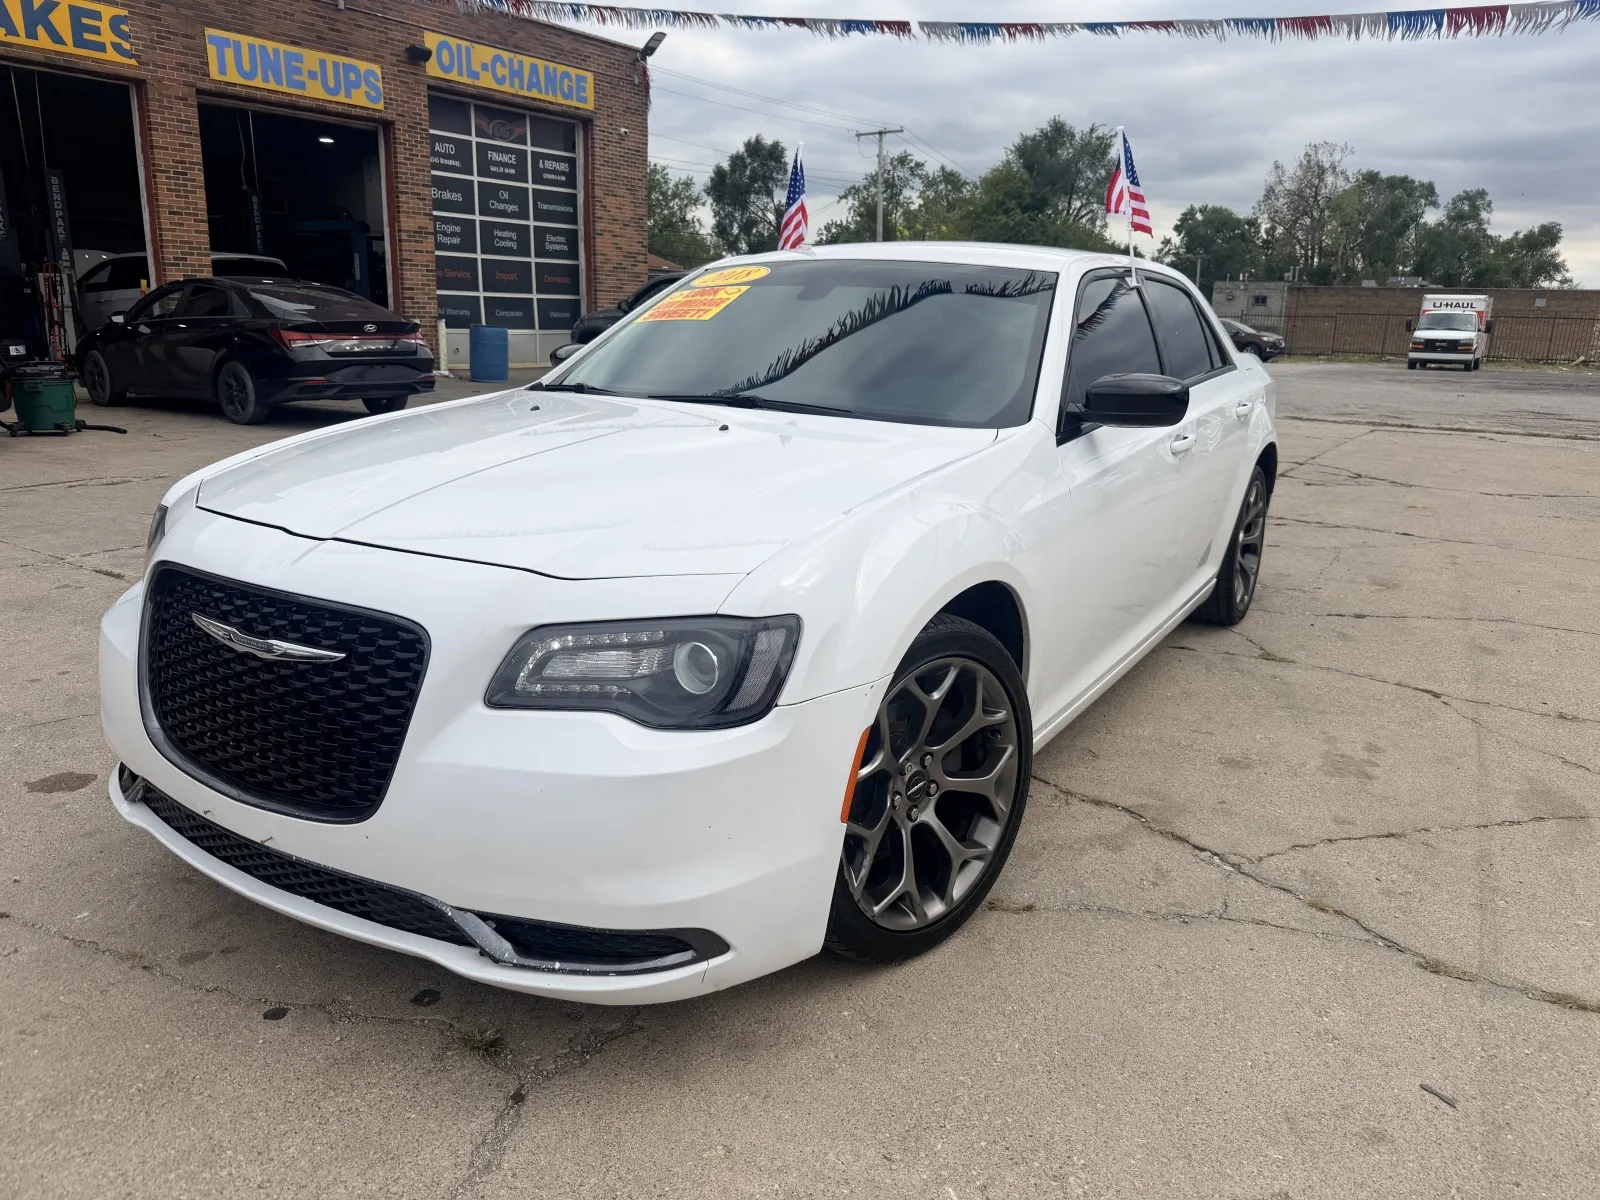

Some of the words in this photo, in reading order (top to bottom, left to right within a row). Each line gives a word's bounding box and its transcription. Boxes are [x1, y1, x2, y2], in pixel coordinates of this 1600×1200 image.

[207, 34, 382, 104] TUNE-UPS
[436, 40, 588, 104] OIL-CHANGE
[434, 141, 456, 155] AUTO
[487, 150, 517, 165] FINANCE
[539, 159, 544, 169] &
[544, 160, 569, 172] REPAIRS
[431, 188, 463, 202] Brakes
[499, 190, 509, 200] Oil
[489, 200, 519, 213] Changes
[537, 201, 574, 213] Transmissions
[436, 222, 462, 234] Engine
[437, 234, 461, 246] Repair
[493, 229, 517, 240] Heating
[546, 234, 567, 243] Electric
[494, 238, 518, 250] Cooling
[545, 242, 568, 252] Systems
[1433, 301, 1476, 309] U-HAUL
[446, 308, 471, 318] Warranty
[495, 309, 524, 318] Companies
[643, 308, 714, 320] SWEET!
